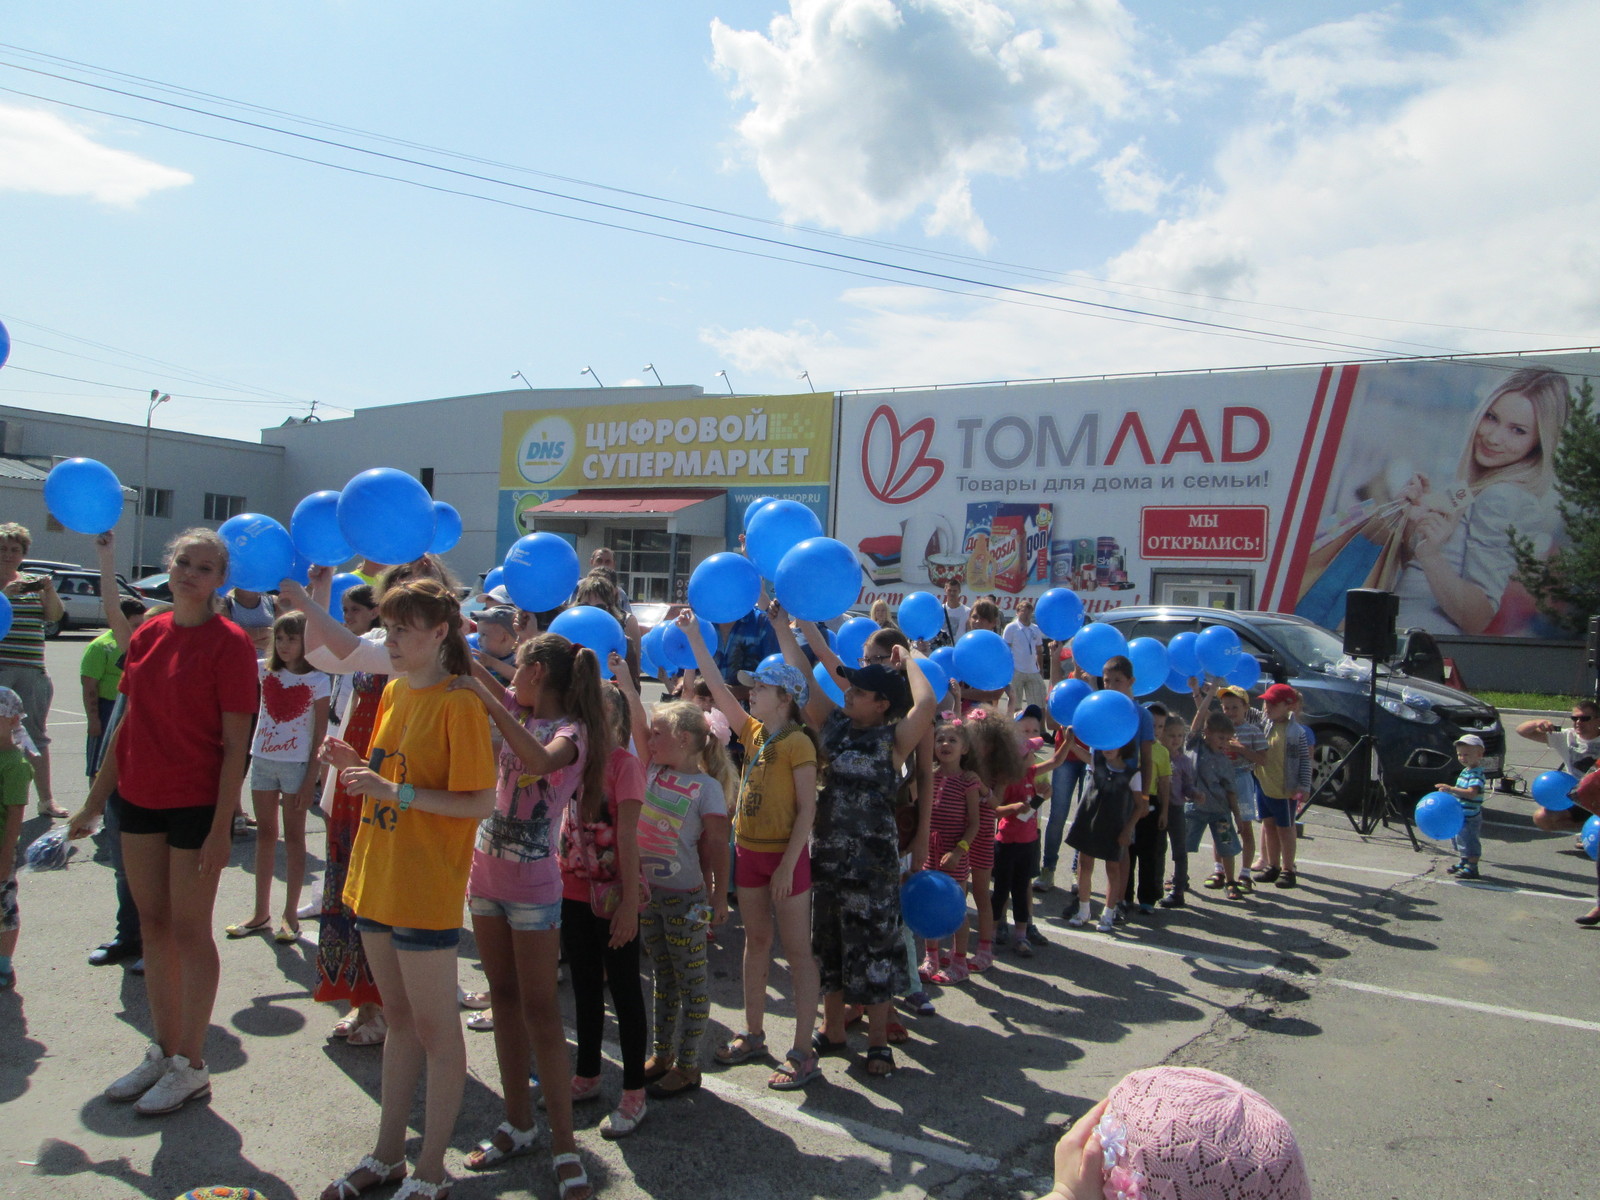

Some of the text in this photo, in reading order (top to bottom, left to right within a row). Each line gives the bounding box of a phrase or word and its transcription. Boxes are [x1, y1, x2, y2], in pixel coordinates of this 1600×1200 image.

[585, 408, 768, 451] ЦИФРОВОЙ
[526, 441, 566, 460] DNS
[582, 447, 809, 480] СУПЕРМАРКЕТ
[956, 470, 1269, 495] Товары для дома и семьи!
[1188, 514, 1219, 528] МЫ
[1147, 535, 1261, 551] ОТКРЫЛИСЬ!
[261, 736, 298, 753] heart
